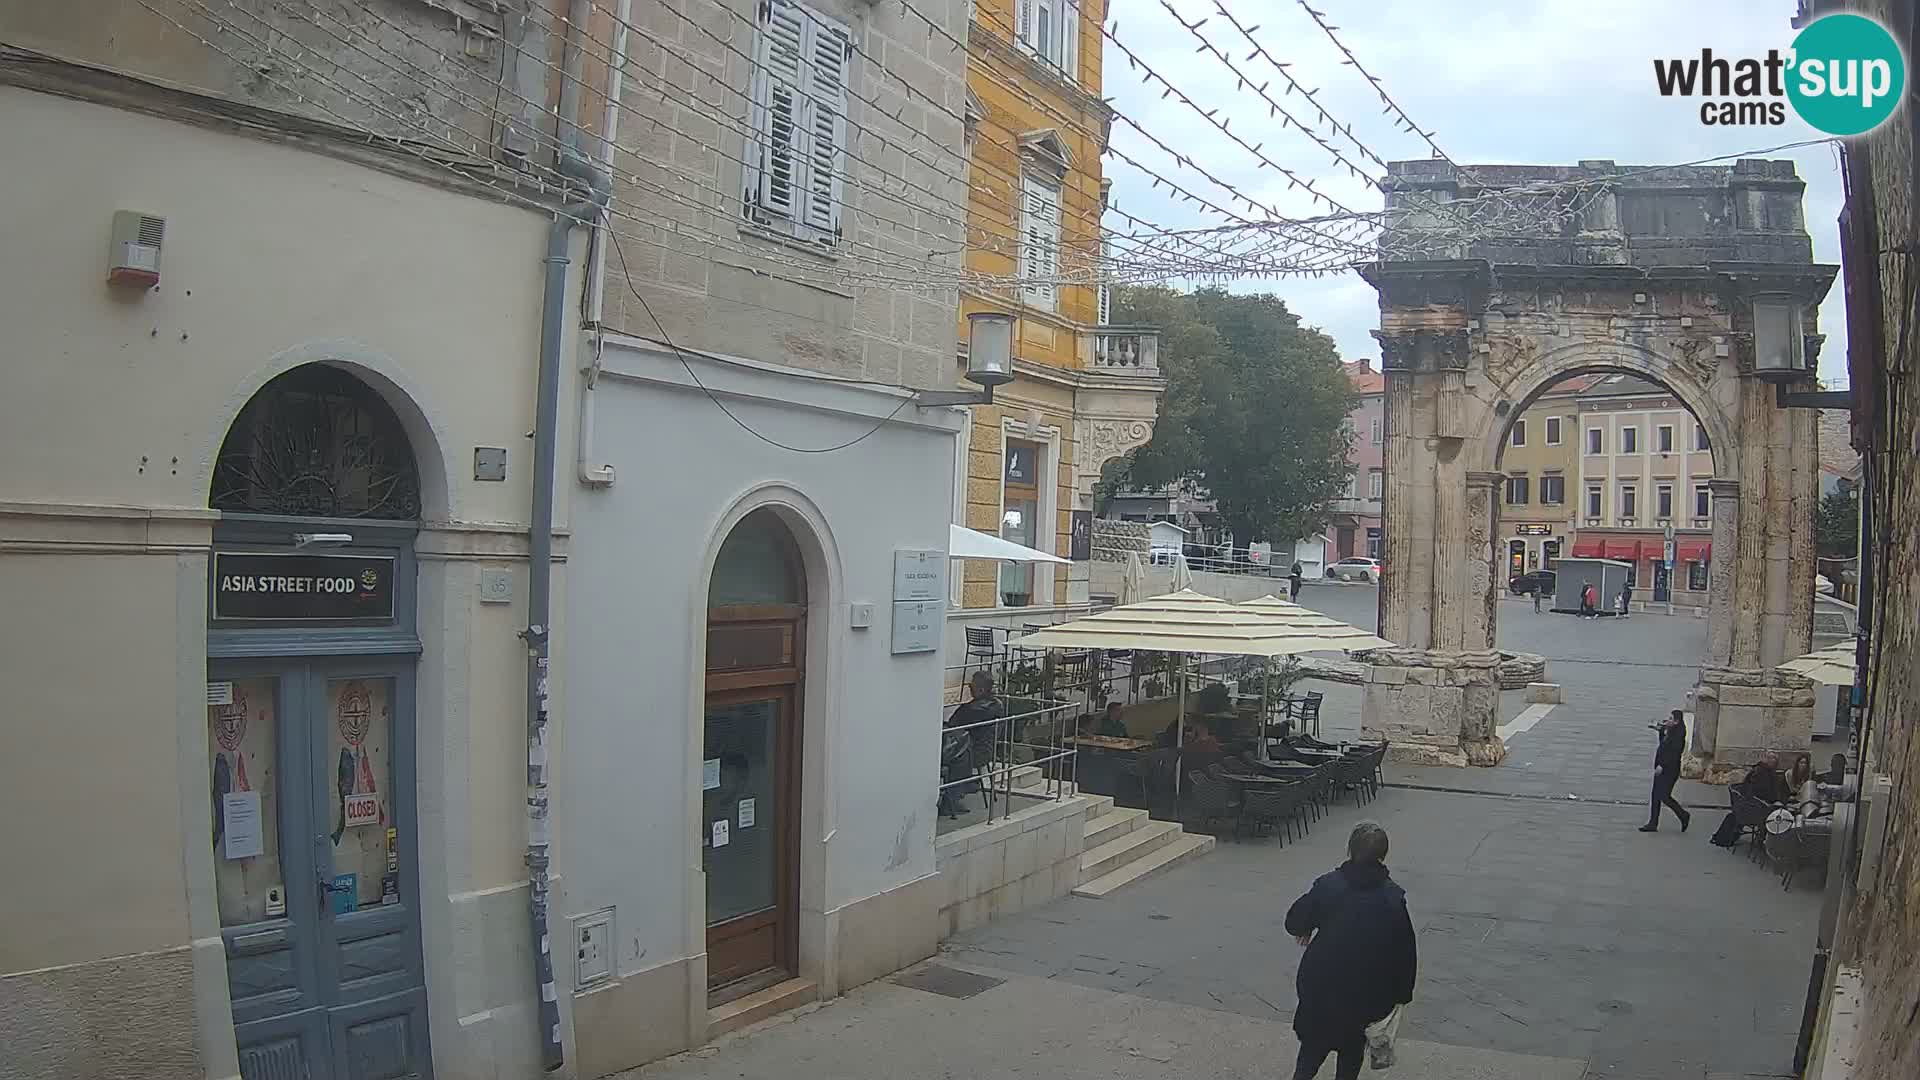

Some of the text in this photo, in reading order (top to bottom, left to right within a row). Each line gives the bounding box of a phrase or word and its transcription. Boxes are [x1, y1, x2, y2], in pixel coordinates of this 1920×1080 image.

[221, 575, 356, 593] ASIA STREET FOOD
[347, 799, 377, 819] CLOSED
